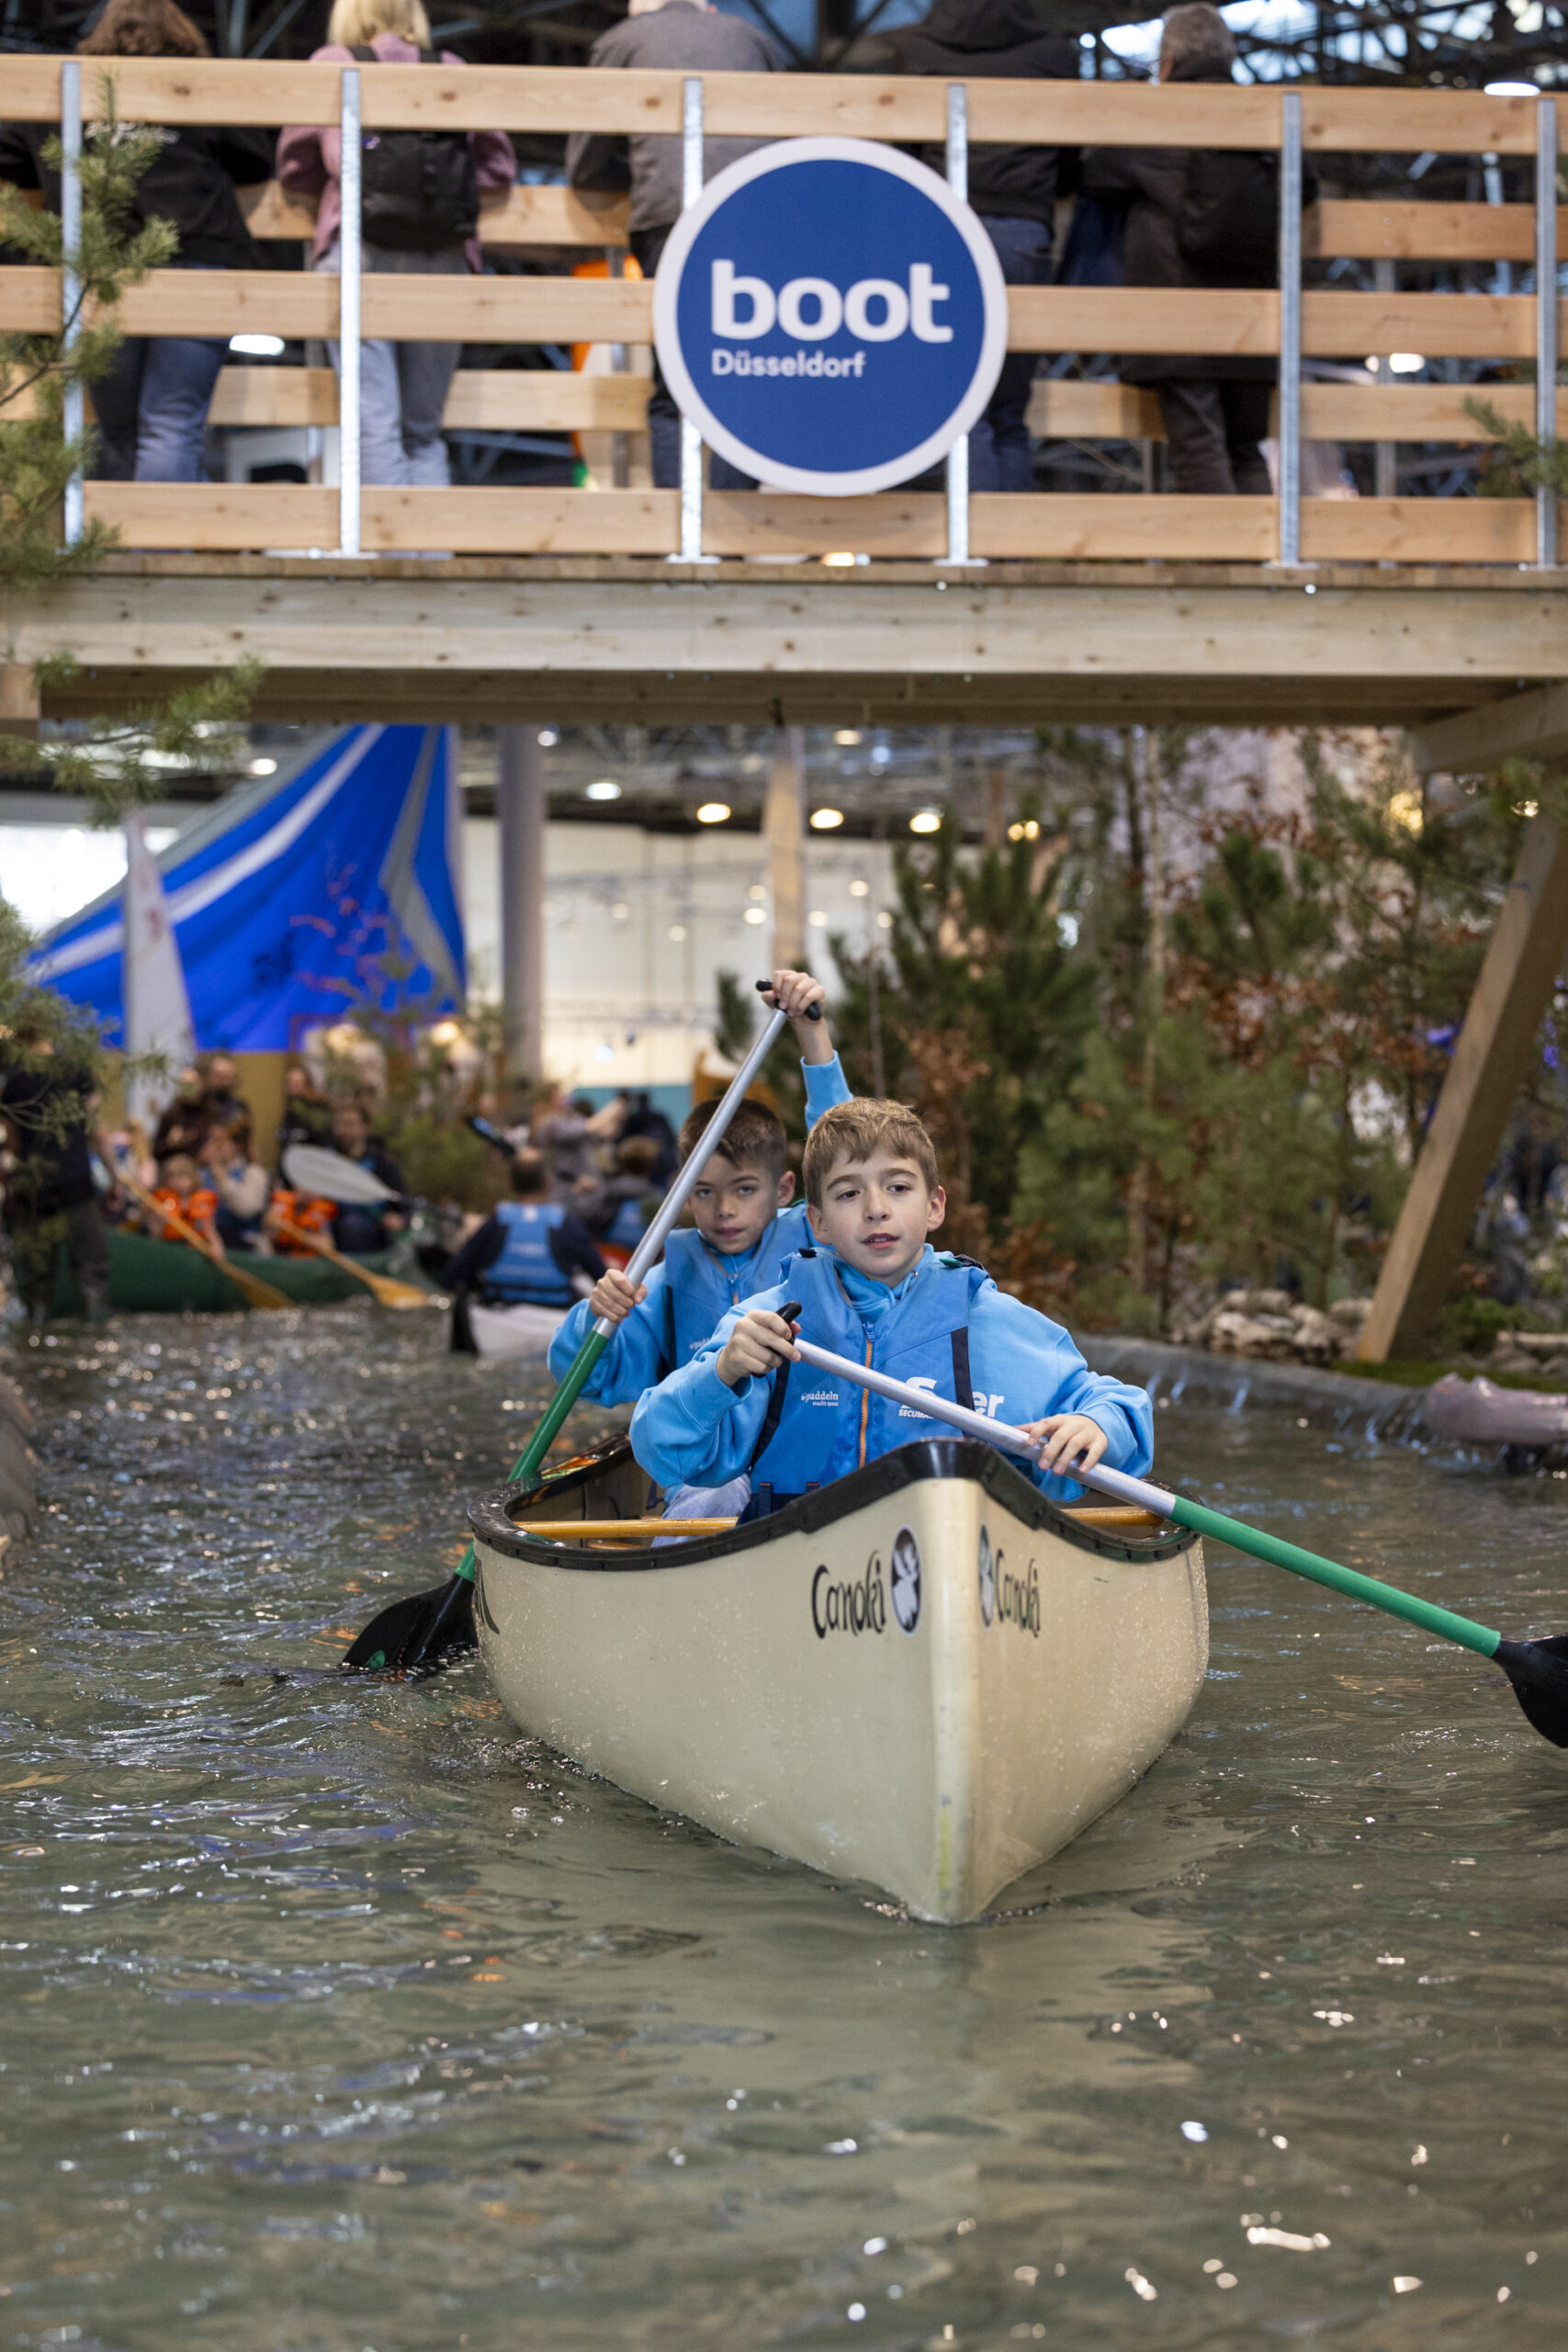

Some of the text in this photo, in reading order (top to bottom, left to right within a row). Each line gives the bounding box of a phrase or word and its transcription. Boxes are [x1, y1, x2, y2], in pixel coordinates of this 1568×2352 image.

[712, 259, 953, 343] boot
[711, 348, 865, 378] Düsseldorf
[804, 1390, 839, 1403] paddeln
[898, 1408, 934, 1419] SECUMA
[812, 1549, 886, 1639] Canoki
[995, 1547, 1041, 1638] Canoki
